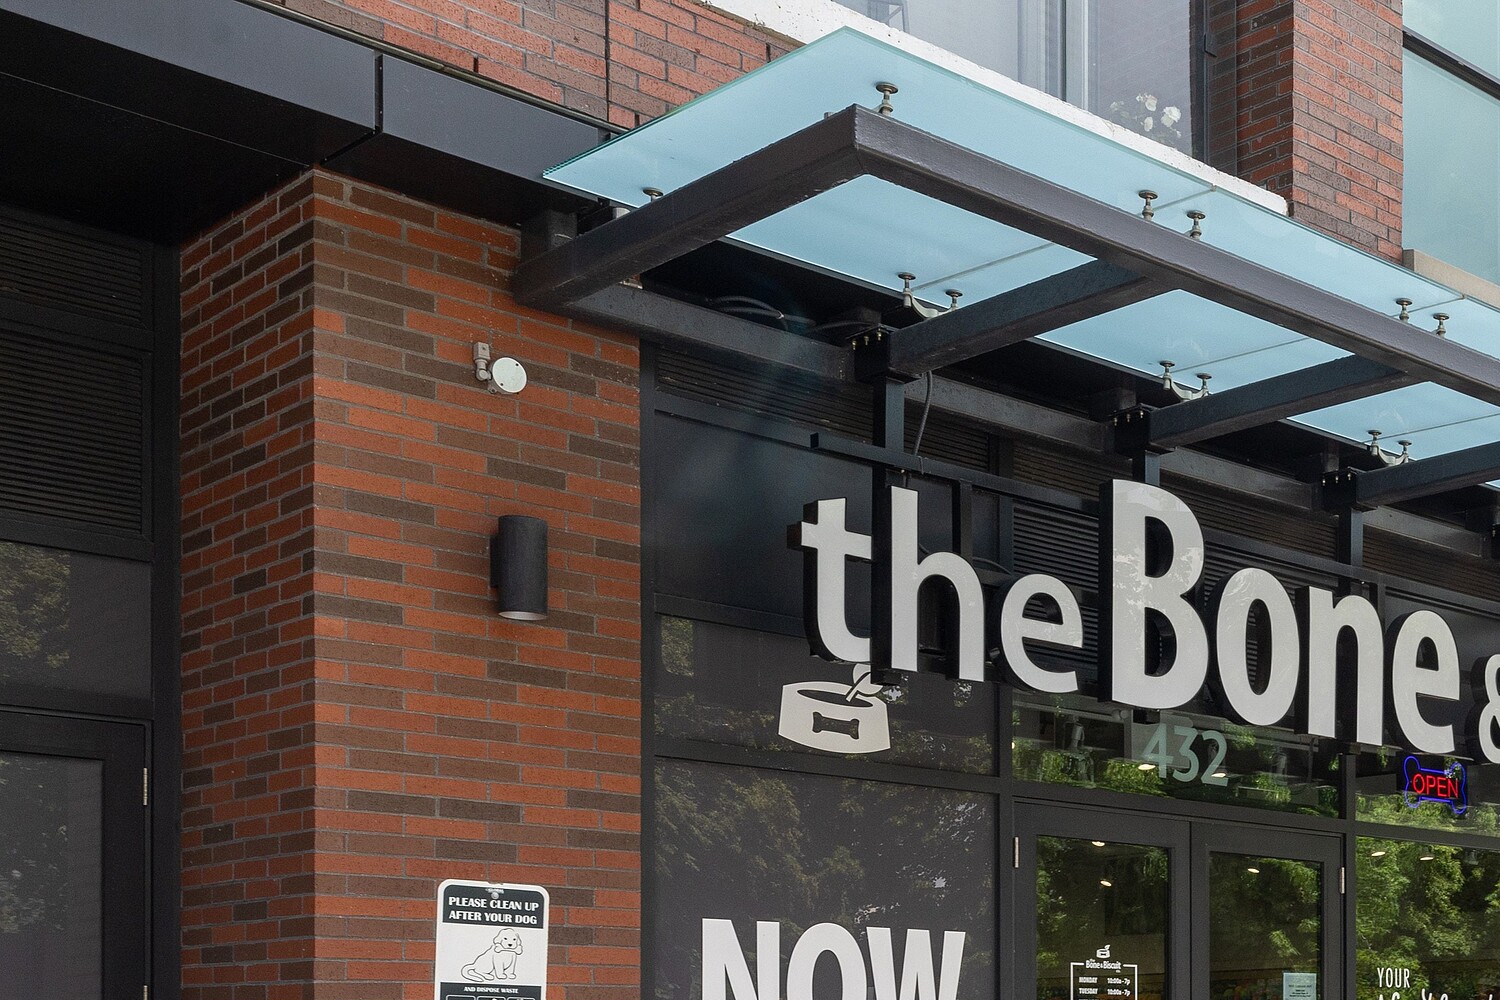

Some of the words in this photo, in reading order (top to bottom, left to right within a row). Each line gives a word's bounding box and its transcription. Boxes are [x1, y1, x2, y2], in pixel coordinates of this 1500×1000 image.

[1111, 479, 1461, 754] Bone
[1142, 723, 1229, 787] 432
[1410, 773, 1459, 799] OPEN
[448, 896, 487, 908] PLEASE
[490, 900, 522, 910] CLEAN
[524, 902, 540, 912] UP
[448, 910, 482, 921] AFTER
[484, 912, 512, 923] YOUR
[515, 915, 538, 924] DOG
[1377, 967, 1410, 988] YOUR
